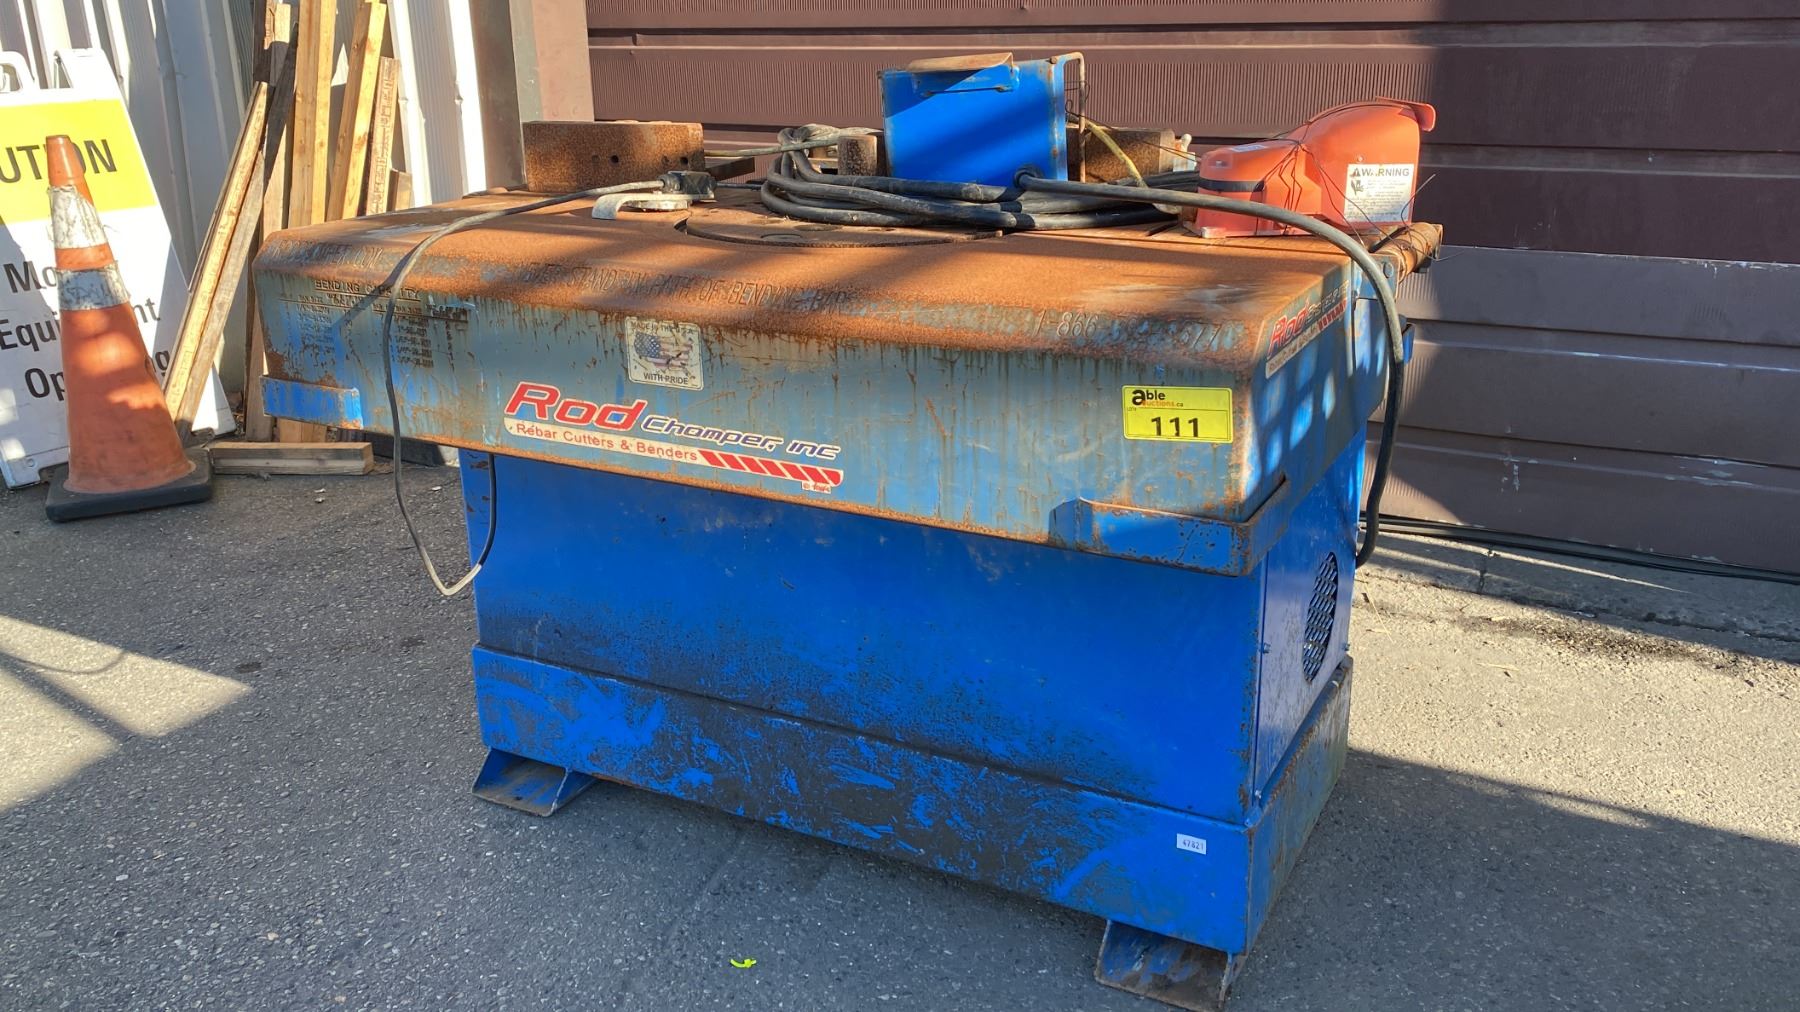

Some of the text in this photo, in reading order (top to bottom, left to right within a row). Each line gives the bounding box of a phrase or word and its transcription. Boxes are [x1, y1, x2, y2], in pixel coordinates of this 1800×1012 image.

[0, 139, 117, 183] UTN
[314, 278, 361, 293] BENDING
[699, 279, 725, 303] OF
[643, 372, 689, 385] WITH PRIDE
[505, 382, 648, 431] Rod
[1151, 417, 1199, 437] 111
[516, 422, 698, 462] Rebar Cutters & Benders
